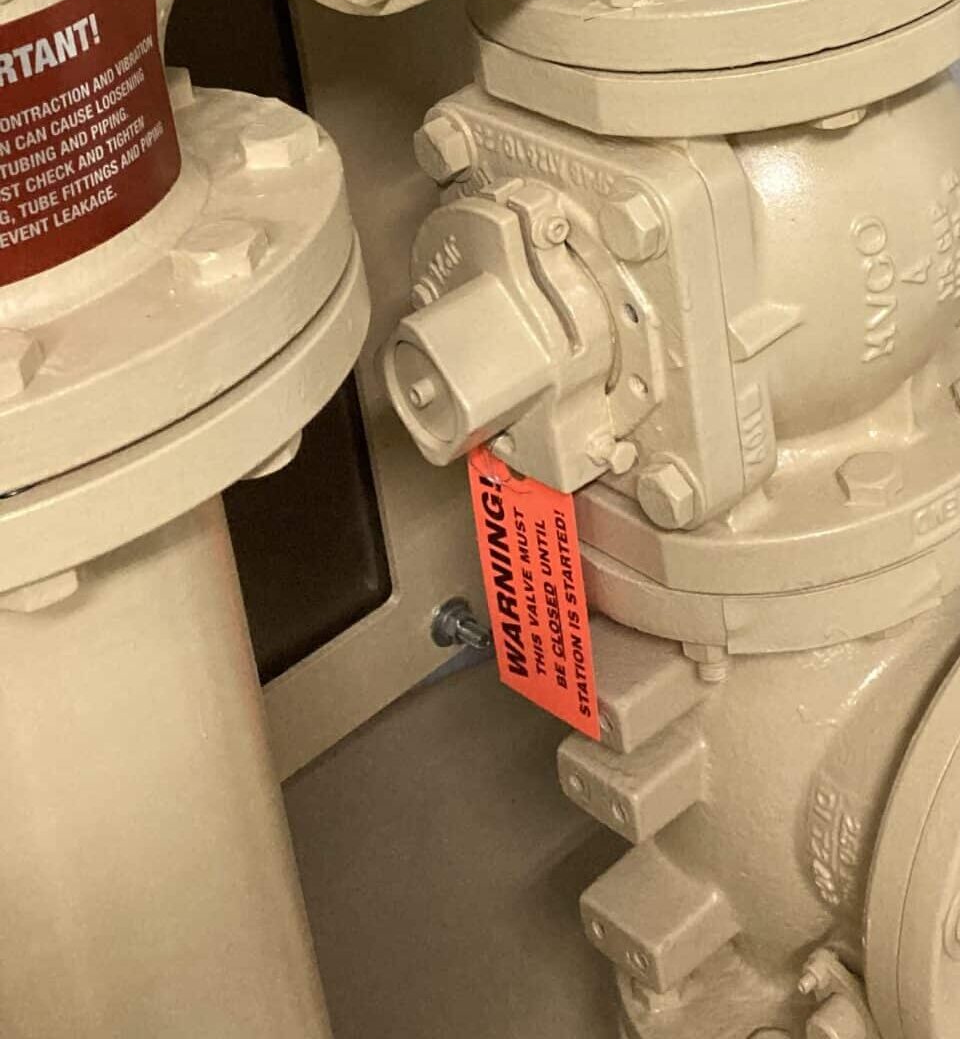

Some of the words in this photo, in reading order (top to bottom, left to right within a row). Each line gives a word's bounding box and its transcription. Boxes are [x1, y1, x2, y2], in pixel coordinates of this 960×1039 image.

[0, 13, 101, 87] RTANT!
[0, 82, 91, 133] ONTRACTION
[93, 68, 115, 93] AND
[114, 34, 153, 76] VIBRATION
[0, 146, 57, 179] TUBING
[60, 131, 88, 156] AND
[90, 107, 129, 140] PIPING.
[15, 127, 47, 150] CAN
[50, 104, 94, 136] CAUSE
[95, 68, 145, 114] LOOSENING
[17, 191, 59, 218] TUBE
[61, 160, 119, 201] FITTINGS
[121, 144, 140, 169] AND
[25, 160, 75, 192] CHECK
[78, 145, 104, 170] AND
[105, 115, 144, 154] TIGHTEN
[0, 217, 48, 249] EVENT
[53, 185, 117, 228] LEAKAGE.
[513, 506, 530, 564] MUST
[534, 520, 553, 576] UNTIL
[554, 509, 578, 606] STARTED!
[479, 475, 528, 677] WARNING!
[522, 567, 540, 627] VALVE
[531, 633, 546, 675] THIS
[544, 582, 566, 660] CLOSED
[568, 610, 580, 629] IS
[555, 662, 568, 689] BE
[571, 634, 591, 718] STATION
